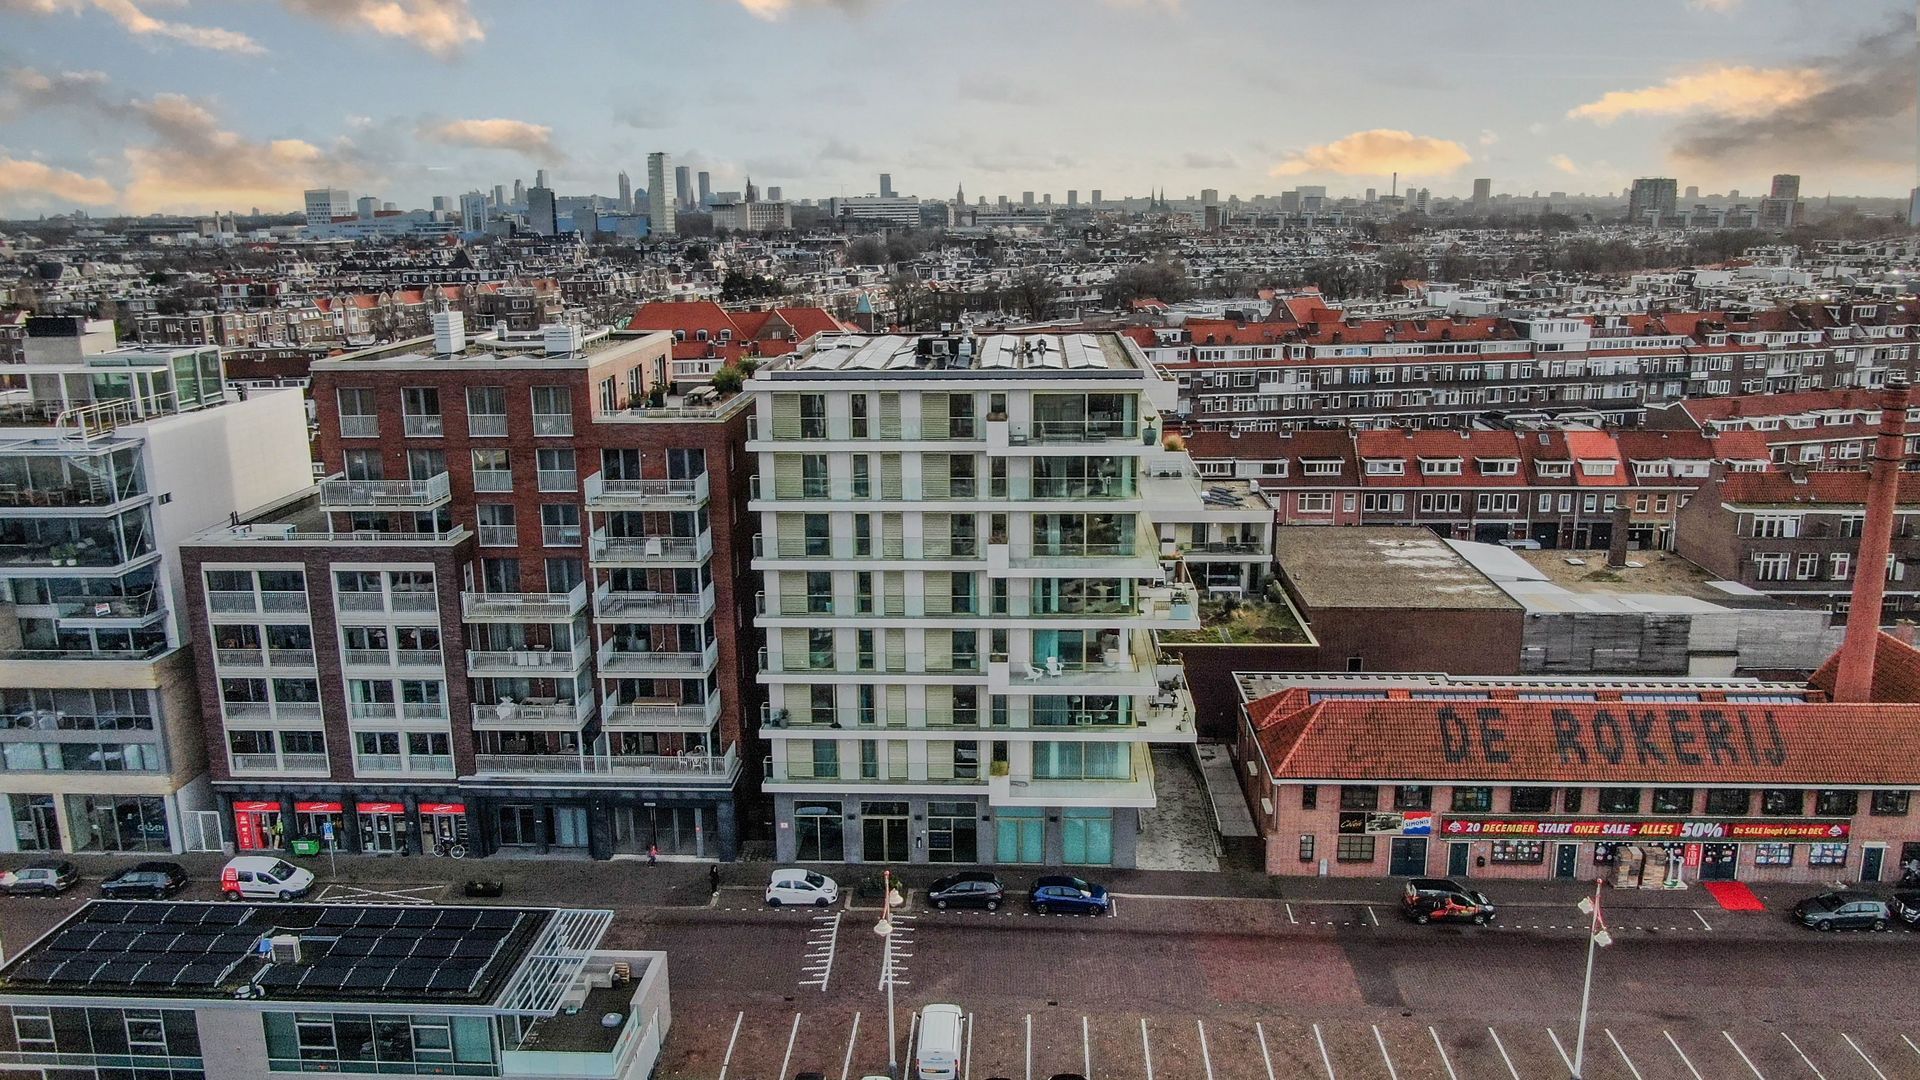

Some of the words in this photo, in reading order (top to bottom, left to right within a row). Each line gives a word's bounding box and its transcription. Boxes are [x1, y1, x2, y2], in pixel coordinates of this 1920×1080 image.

[1437, 706, 1511, 763] DE
[1550, 707, 1787, 766] ROKERIJ
[1405, 819, 1429, 827] SIMONIS
[1466, 822, 1481, 832] 20
[1482, 824, 1534, 833] DECEMBER
[1537, 823, 1572, 833] START
[1573, 825, 1600, 834] ONZE
[1602, 824, 1630, 834] SALE
[1639, 824, 1674, 835] ALLES
[1680, 822, 1723, 838] 50%
[1744, 827, 1763, 835] SALE
[1808, 827, 1823, 835] DEC
